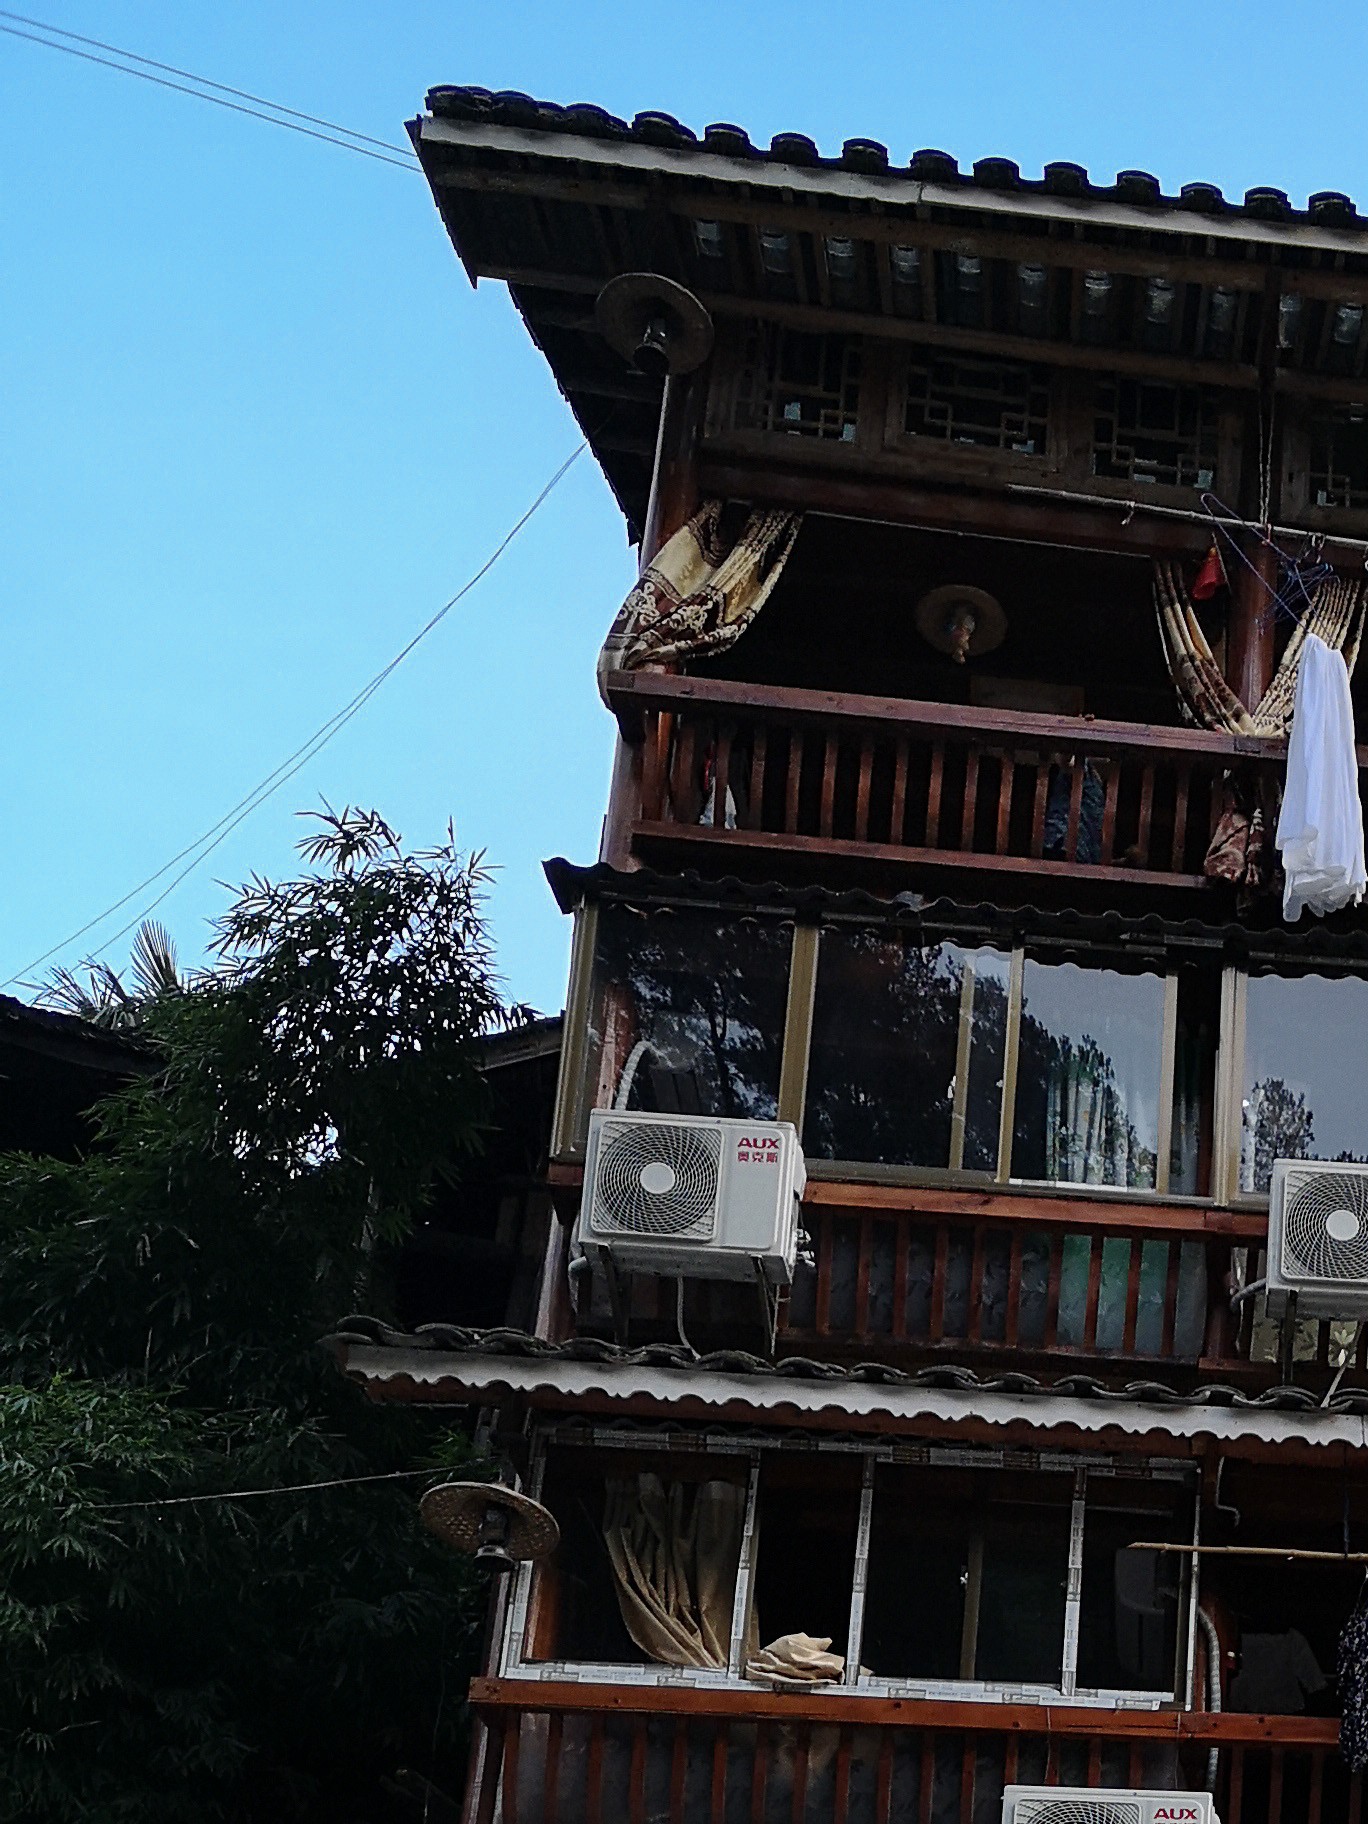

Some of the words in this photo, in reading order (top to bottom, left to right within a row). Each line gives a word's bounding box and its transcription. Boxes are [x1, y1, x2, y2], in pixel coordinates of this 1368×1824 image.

[737, 1137, 780, 1150] AUX
[737, 1151, 778, 1163] 奥克斯
[1153, 1808, 1198, 1820] AUX
